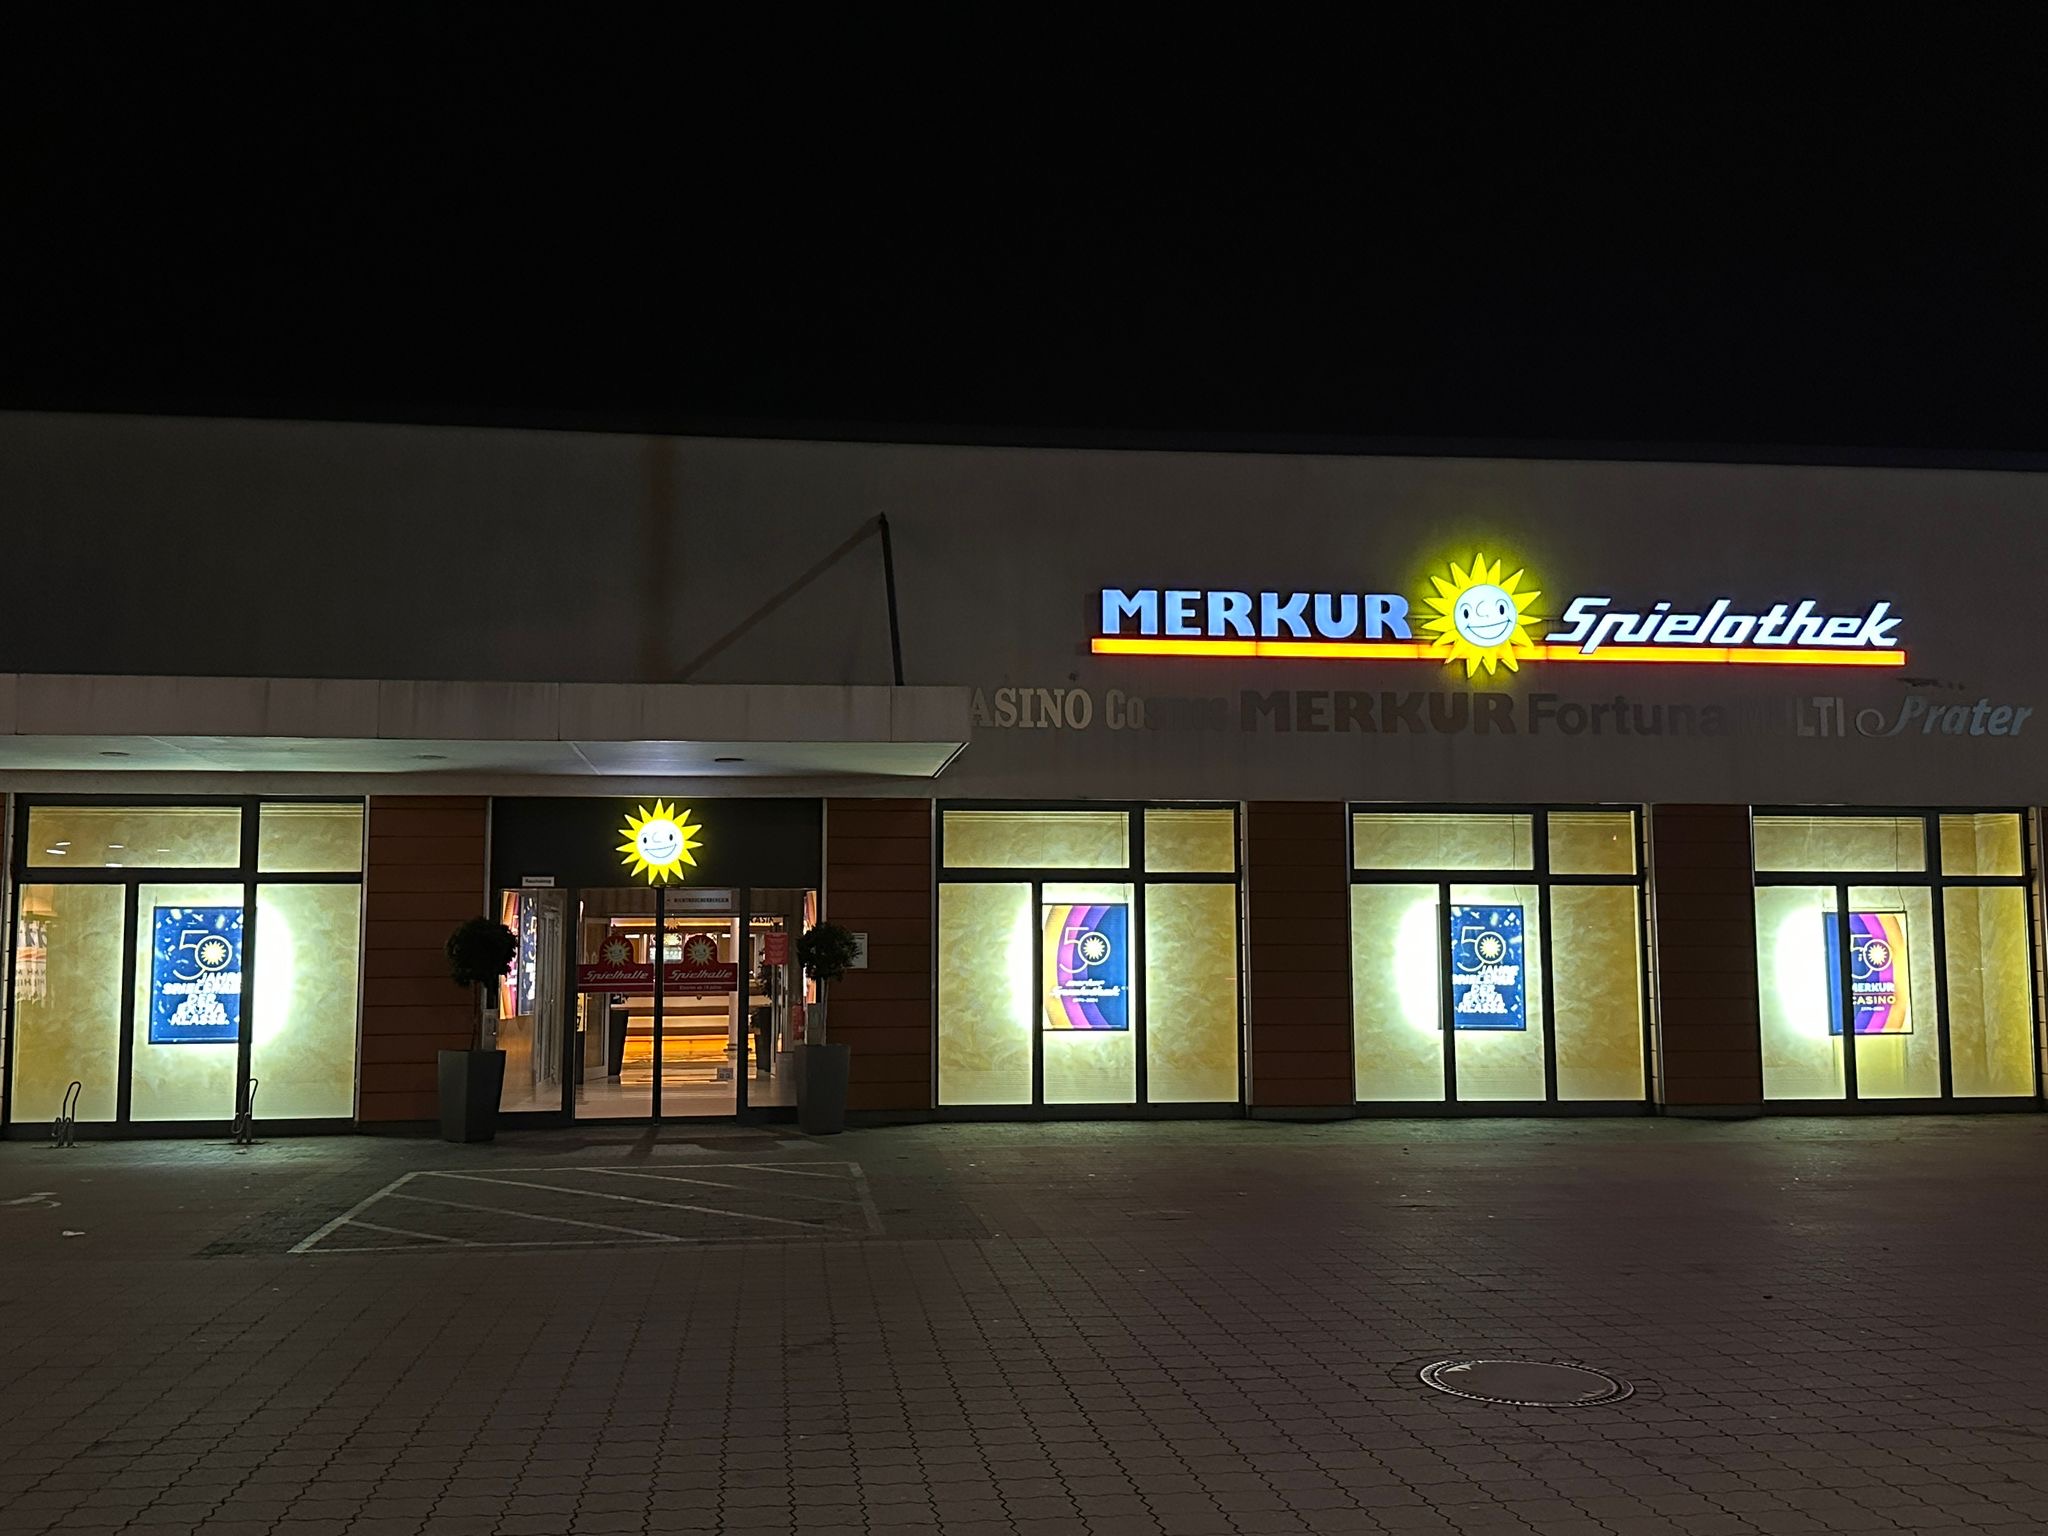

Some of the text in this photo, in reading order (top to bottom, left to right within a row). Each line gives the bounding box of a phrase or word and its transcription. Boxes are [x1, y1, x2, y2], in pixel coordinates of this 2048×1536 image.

[1101, 588, 1906, 655] MERKUR Spielothek
[1240, 690, 1517, 735] MERKUR
[1857, 695, 2034, 738] Prater
[583, 969, 649, 982] Spielhalle
[668, 968, 734, 981] Spielhalle
